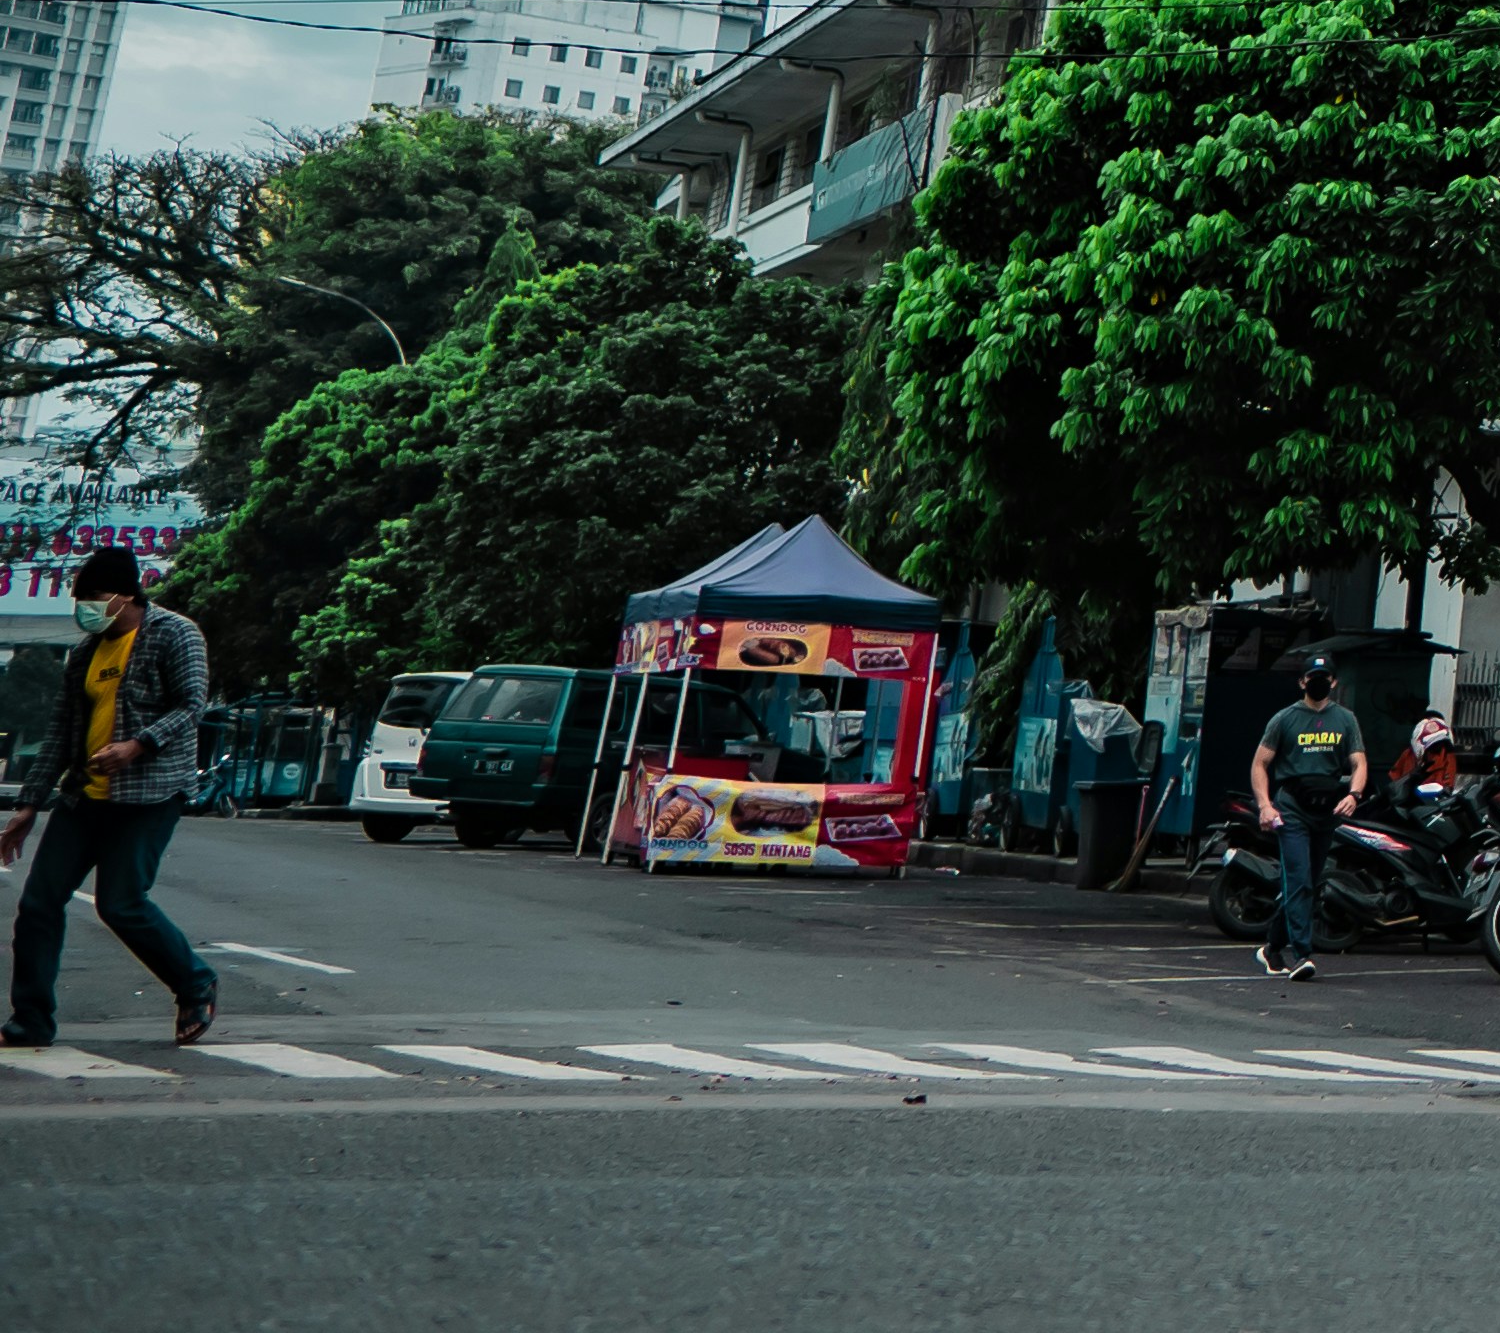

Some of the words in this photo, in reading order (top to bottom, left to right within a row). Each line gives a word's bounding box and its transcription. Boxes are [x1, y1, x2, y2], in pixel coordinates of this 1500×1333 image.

[50, 482, 169, 505] AVAILABLE
[746, 621, 807, 634] CORNDOG
[1297, 731, 1343, 746] CIPARAY
[723, 841, 756, 858] SOSIS
[760, 842, 812, 860] KENTANG
